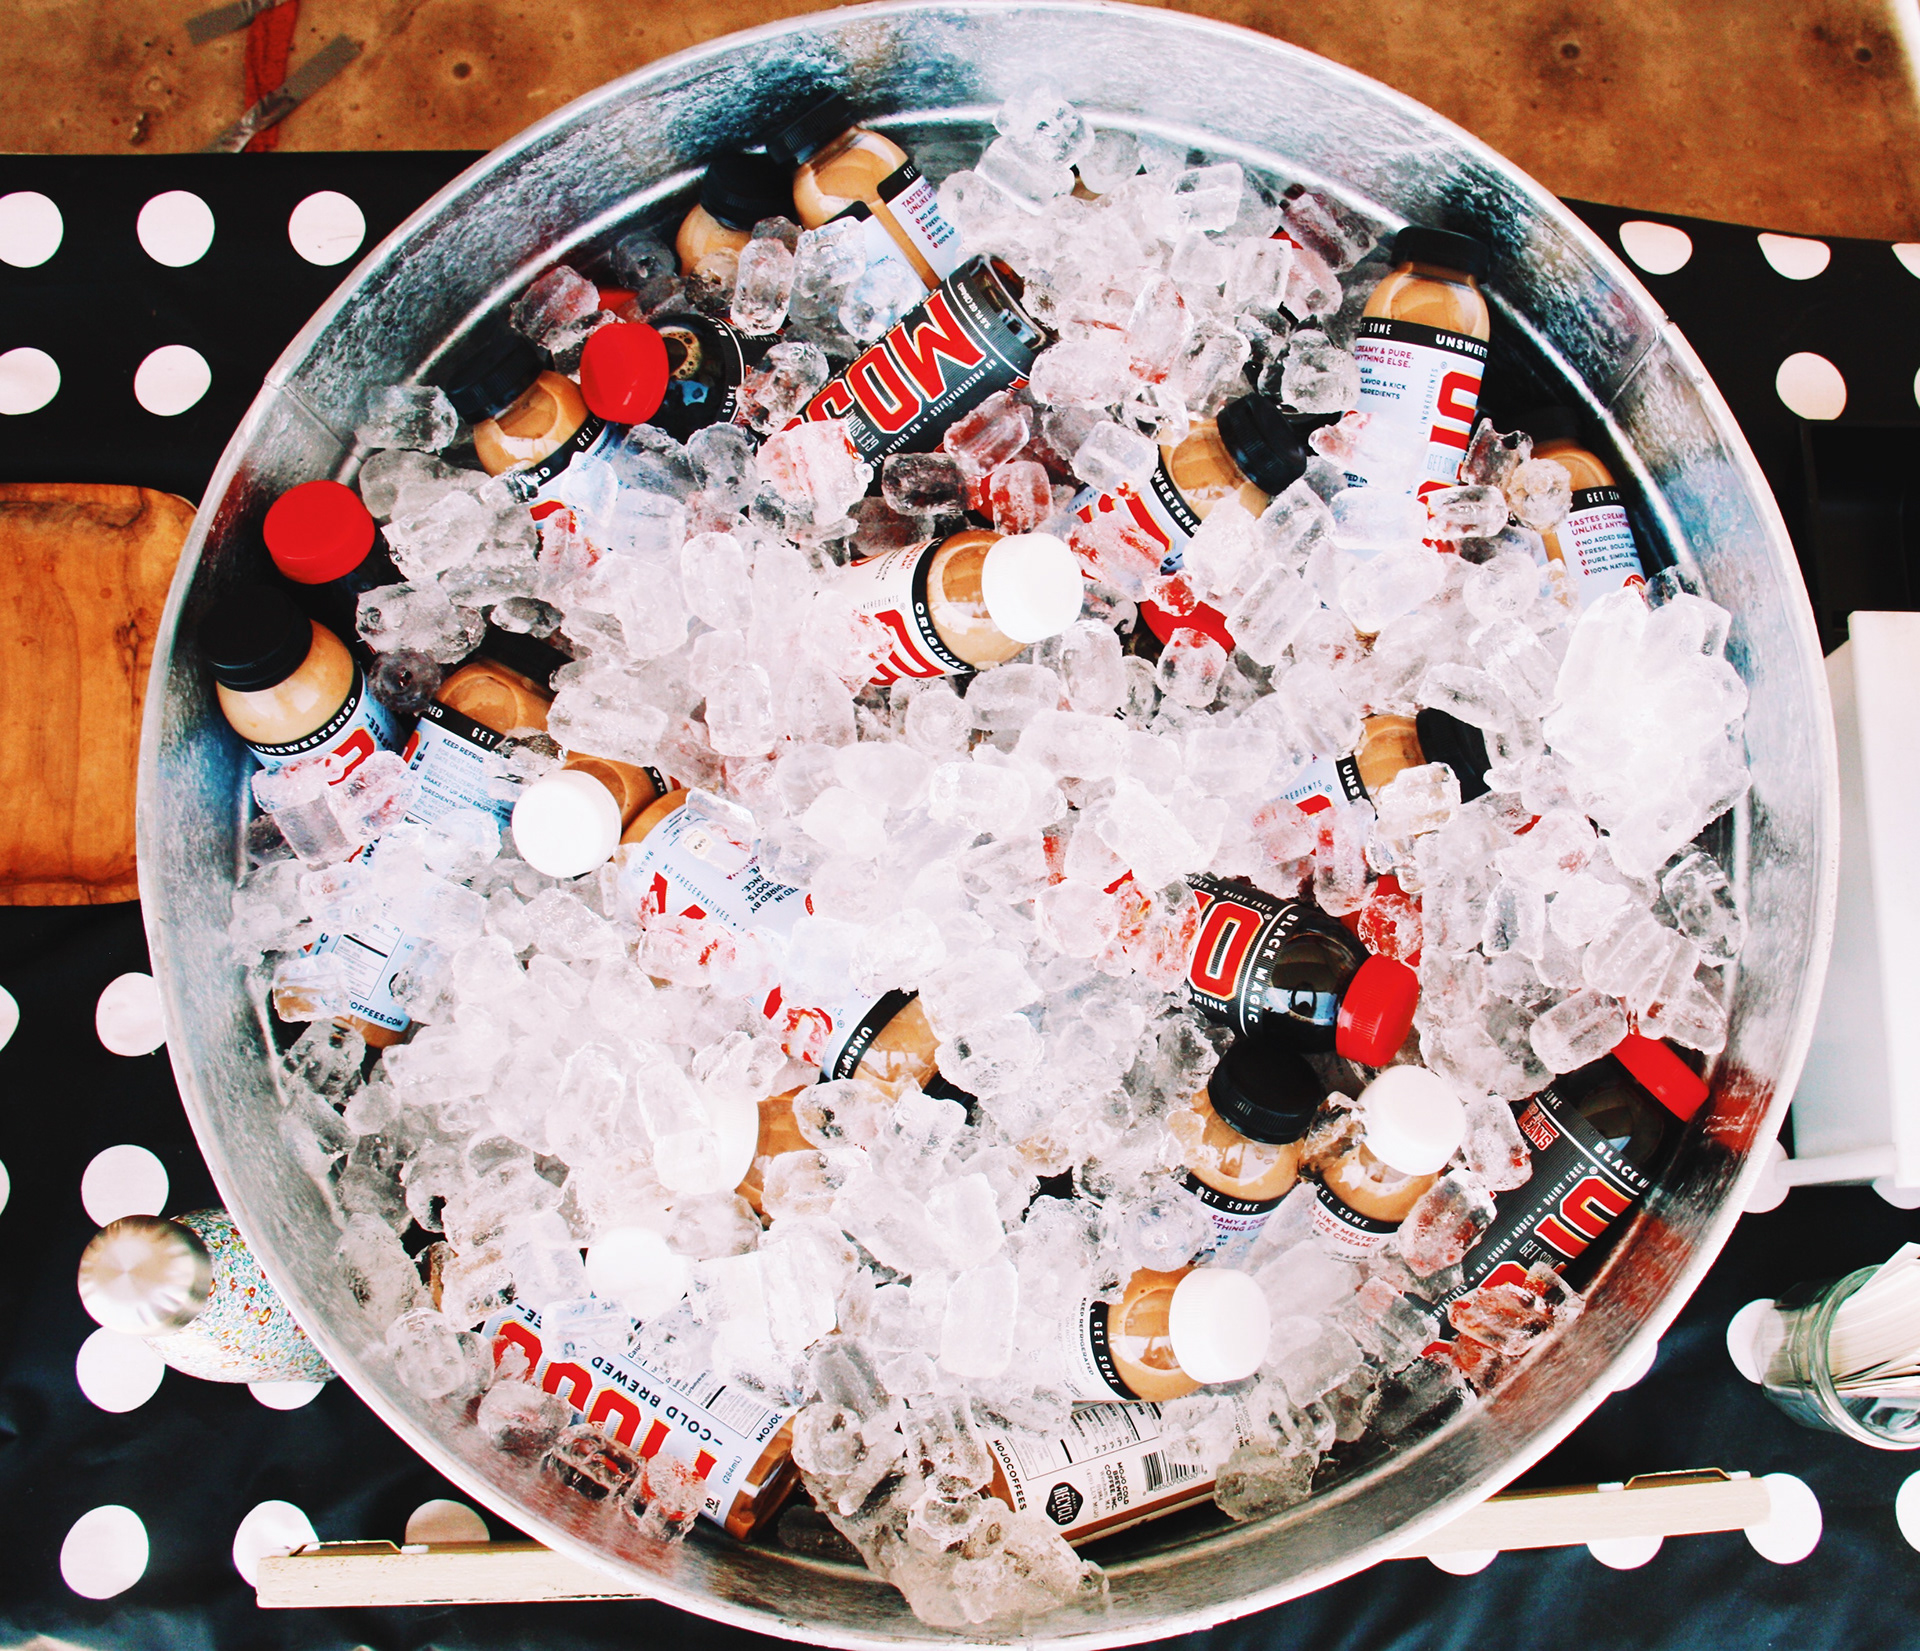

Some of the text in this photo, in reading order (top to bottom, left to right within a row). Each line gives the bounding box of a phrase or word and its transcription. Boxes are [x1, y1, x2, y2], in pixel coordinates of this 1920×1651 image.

[901, 189, 924, 208] TASTES
[907, 196, 929, 215] UNLIKE
[1368, 322, 1393, 336] SOME
[780, 289, 987, 434] MO
[1387, 357, 1412, 369] ELSE.
[1388, 348, 1415, 360] PURE.
[930, 369, 985, 417] PRESERVATIVES
[1389, 382, 1407, 391] KICK
[722, 385, 738, 414] SOME
[885, 434, 910, 453] SUGAR
[1586, 491, 1605, 504] GET
[1568, 514, 1601, 528] TASTES
[1571, 523, 1603, 536] UNLIKE
[1581, 538, 1593, 546] NO
[1594, 534, 1616, 543] ADDED
[1590, 561, 1636, 575] 100% NATURAL
[254, 697, 357, 755] UNSWEETENED
[471, 727, 495, 746] GET
[442, 738, 460, 750] KEEP
[423, 775, 442, 788] SHAKE
[449, 788, 459, 796] UP
[458, 793, 473, 803] AND
[472, 800, 491, 813] ENJOY
[674, 872, 731, 922] PRESERVATIVES
[750, 901, 762, 915] BY
[1247, 913, 1300, 1024] BLACK MAGIC
[1593, 1140, 1640, 1182] BLACK
[1226, 1200, 1260, 1213] SOME
[1337, 1206, 1370, 1229] SOME
[1315, 1219, 1333, 1234] ICE
[1317, 1210, 1380, 1243] LIKE MELTED
[1475, 1262, 1489, 1276] NO
[1487, 1238, 1513, 1263] SUGAR
[1511, 1213, 1536, 1239] ADDED
[1542, 1181, 1567, 1207] DAIRY
[1565, 1162, 1587, 1184] FREE
[1518, 1239, 1539, 1261] GET
[1093, 1321, 1120, 1384] GET SOME
[591, 1355, 662, 1409] BREWED
[666, 1405, 712, 1442] COLD
[721, 1455, 743, 1485] (284mL)
[992, 1439, 1028, 1511] MOJOCOFFEES
[1112, 1470, 1123, 1502] BREWED
[1116, 1461, 1130, 1505] MOJO COLD
[704, 1497, 716, 1510] 90
[1053, 1486, 1074, 1523] RECYCLE
